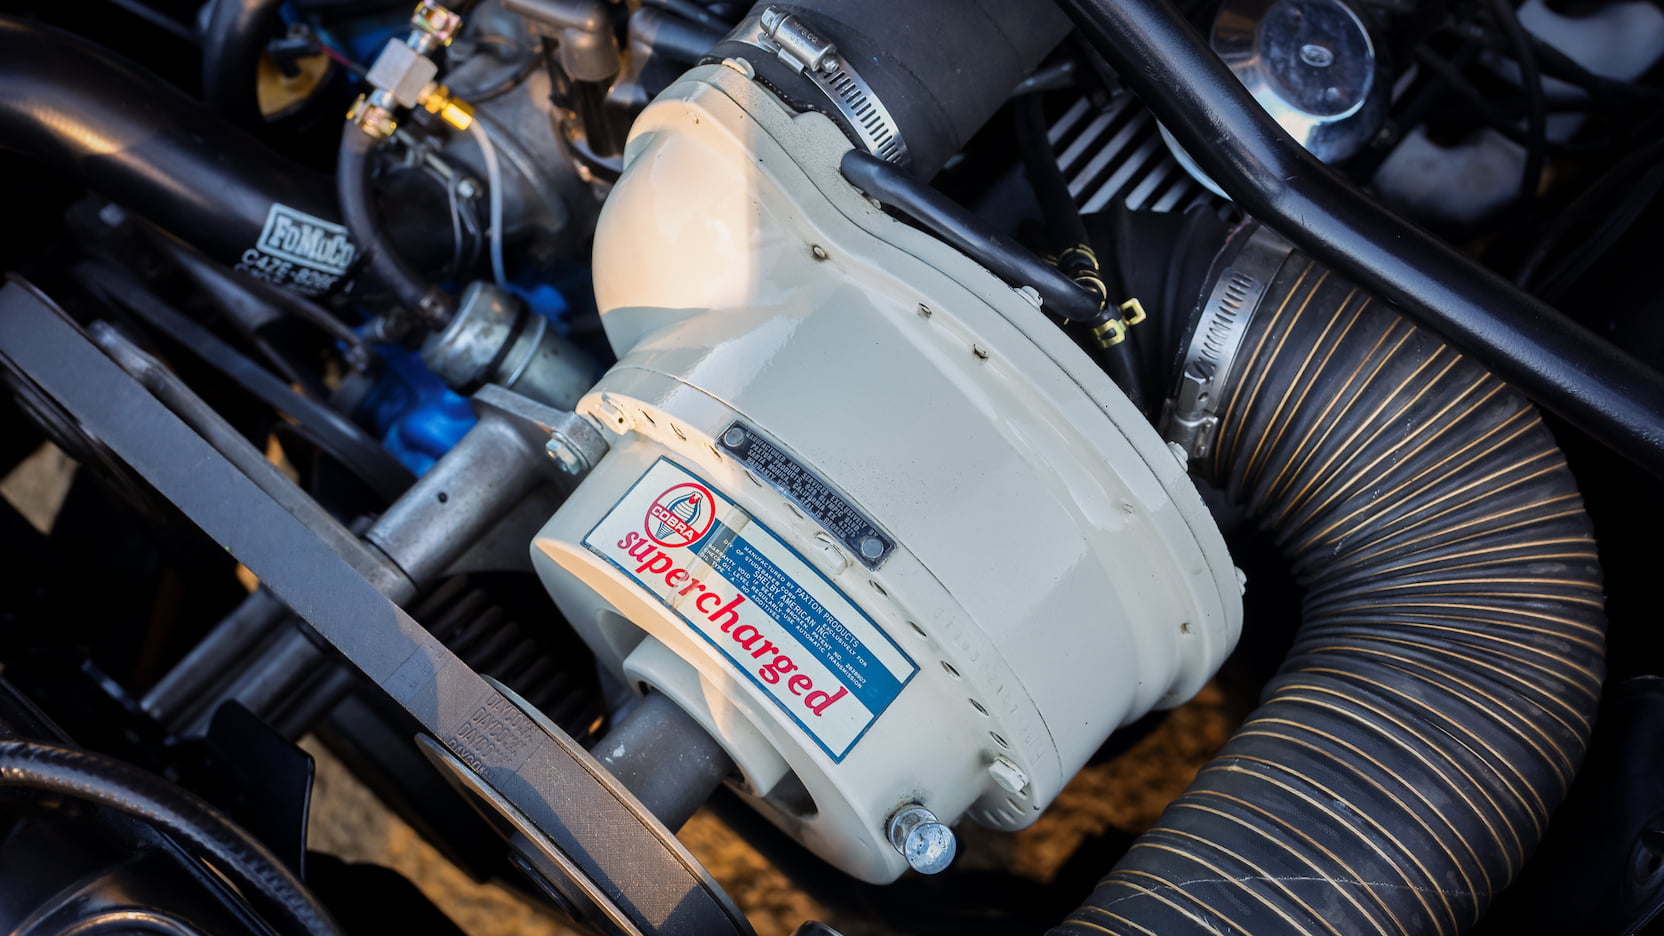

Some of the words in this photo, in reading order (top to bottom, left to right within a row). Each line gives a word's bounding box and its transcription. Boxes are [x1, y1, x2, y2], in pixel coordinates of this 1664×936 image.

[267, 214, 356, 269] FoMoCo
[745, 456, 776, 481] WARRANTY
[798, 496, 813, 510] SEAL
[814, 510, 823, 518] IS
[746, 449, 766, 465] SANTA
[791, 482, 826, 511] CALIFORNIA
[750, 443, 773, 461] PAXTON
[817, 494, 843, 517] OLYMPIC
[843, 516, 861, 533] BLVD.
[786, 461, 800, 473] AND
[830, 495, 867, 529] EXCLUSIVELY
[651, 506, 694, 541] COBRA
[699, 551, 709, 560] OIL
[710, 560, 724, 573] TYPE
[740, 584, 750, 593] NO
[707, 542, 735, 566] WARRANTY
[736, 566, 750, 578] VOID
[760, 585, 775, 600] SEAL
[811, 630, 832, 650] PATENT
[735, 548, 744, 556] OF
[744, 555, 780, 586] STUDEBAKER
[743, 546, 785, 582] MANUFACTURED
[785, 581, 794, 589] BY
[794, 587, 823, 614] PAXTON
[822, 612, 859, 648] PRODUCTS
[617, 531, 848, 716] supercharged
[702, 546, 721, 562] CHECK
[721, 561, 732, 571] OIL
[732, 570, 750, 586] LEVEL
[795, 624, 825, 653] AUTOMATIC
[826, 652, 863, 689] TRANSMISSION
[752, 569, 780, 595] SHELBY
[780, 593, 816, 627] AMERICAN
[814, 625, 831, 641] INC.
[821, 623, 856, 656] EXCLUSIVELY
[855, 655, 867, 667] FOR
[457, 722, 495, 757] DAYCO
[471, 706, 510, 742] DAYCO
[487, 693, 524, 727] DAYCO
